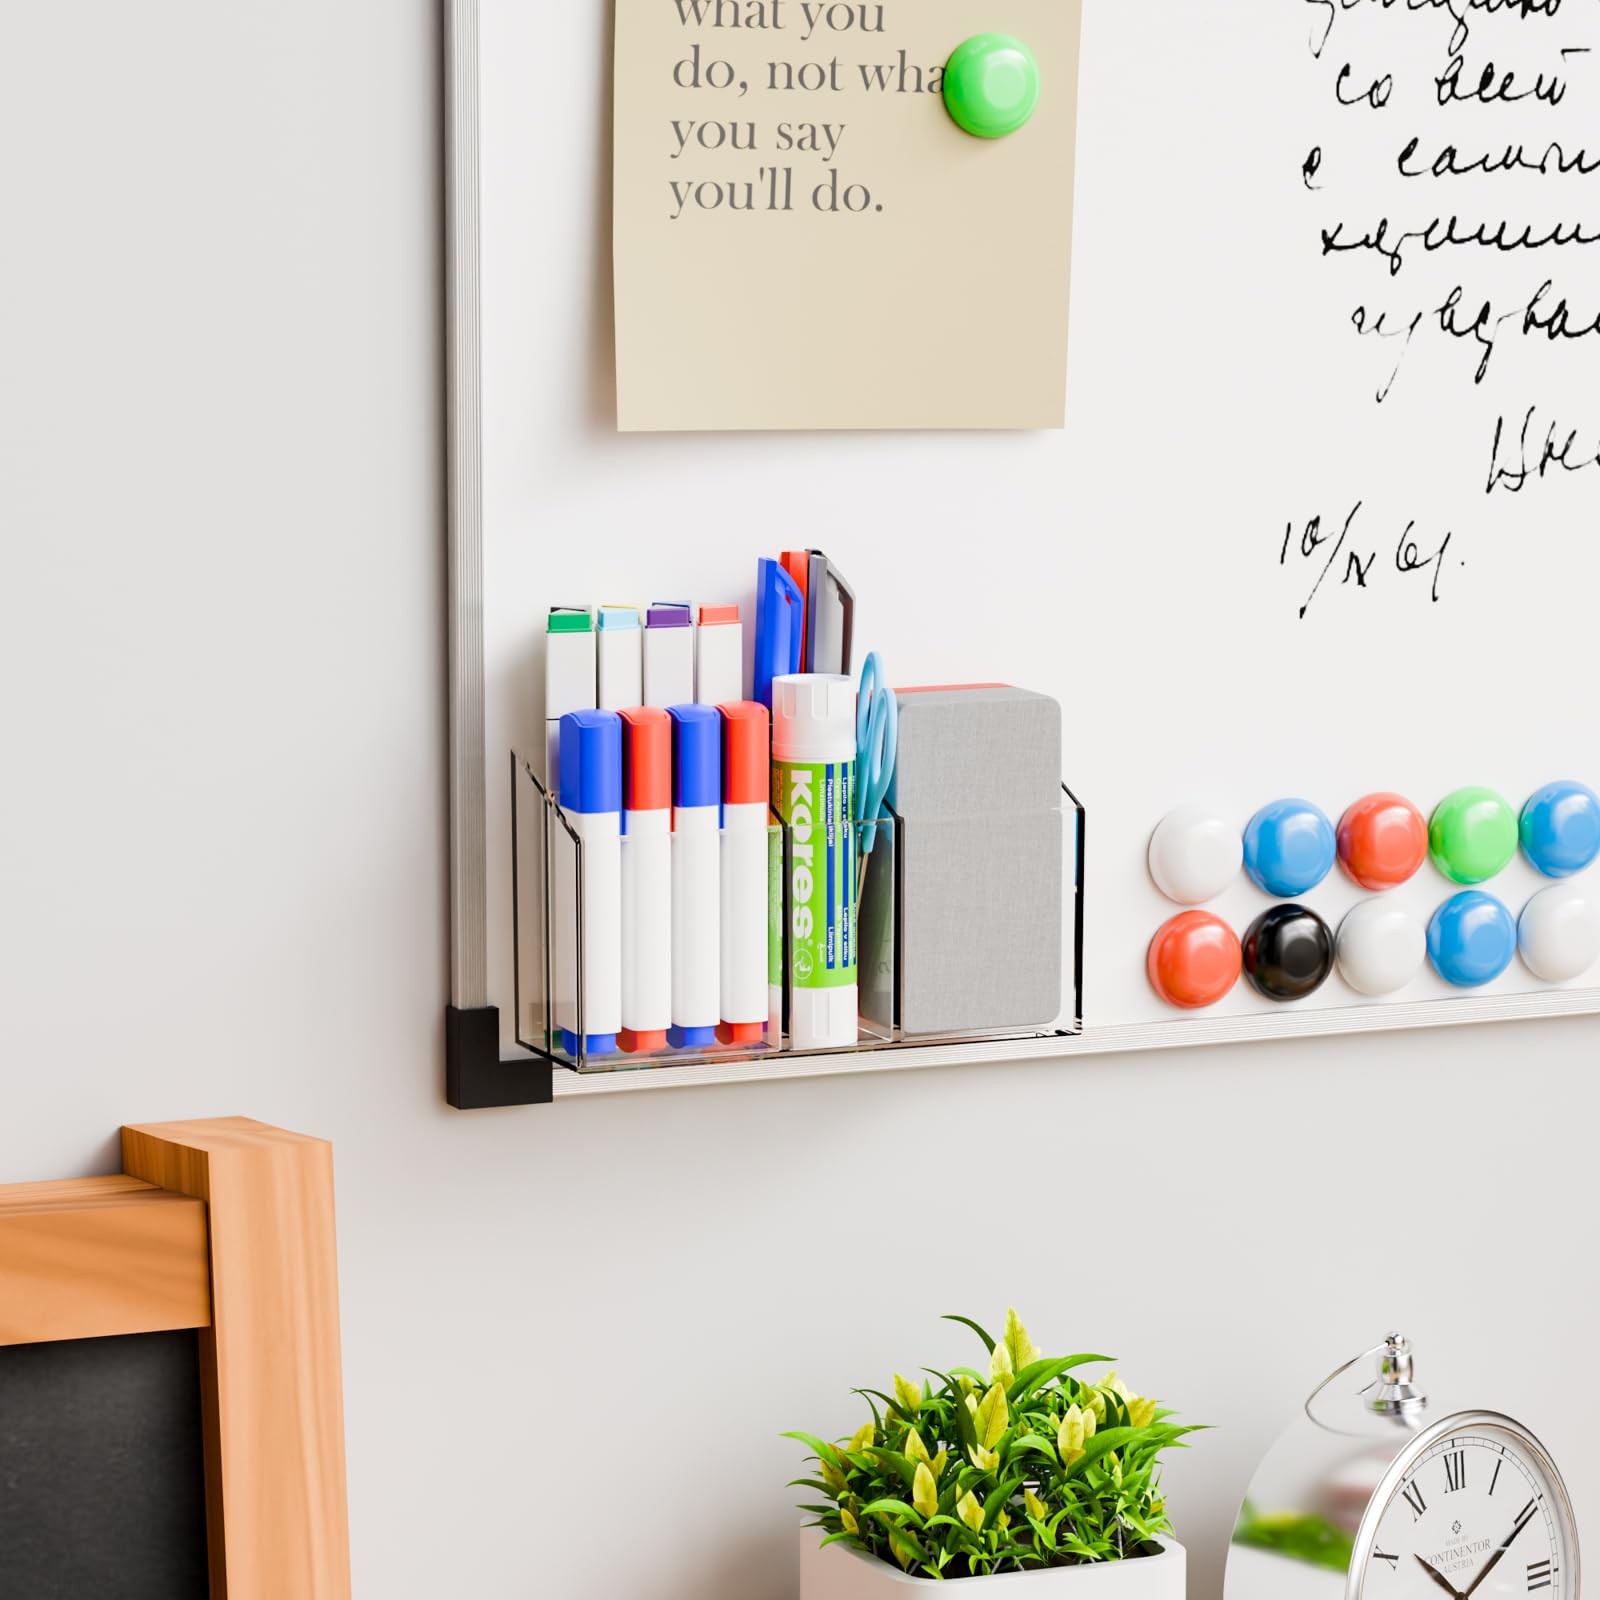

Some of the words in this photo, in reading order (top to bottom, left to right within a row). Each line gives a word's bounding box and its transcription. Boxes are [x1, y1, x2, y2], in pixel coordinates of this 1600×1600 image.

[673, 0, 785, 29] what
[801, 2, 886, 41] you
[672, 44, 749, 97] do,
[767, 56, 844, 92] not
[858, 50, 946, 94] wha
[670, 120, 757, 159] you
[776, 122, 846, 162] say
[669, 166, 794, 220] you'll
[811, 168, 883, 213] do.
